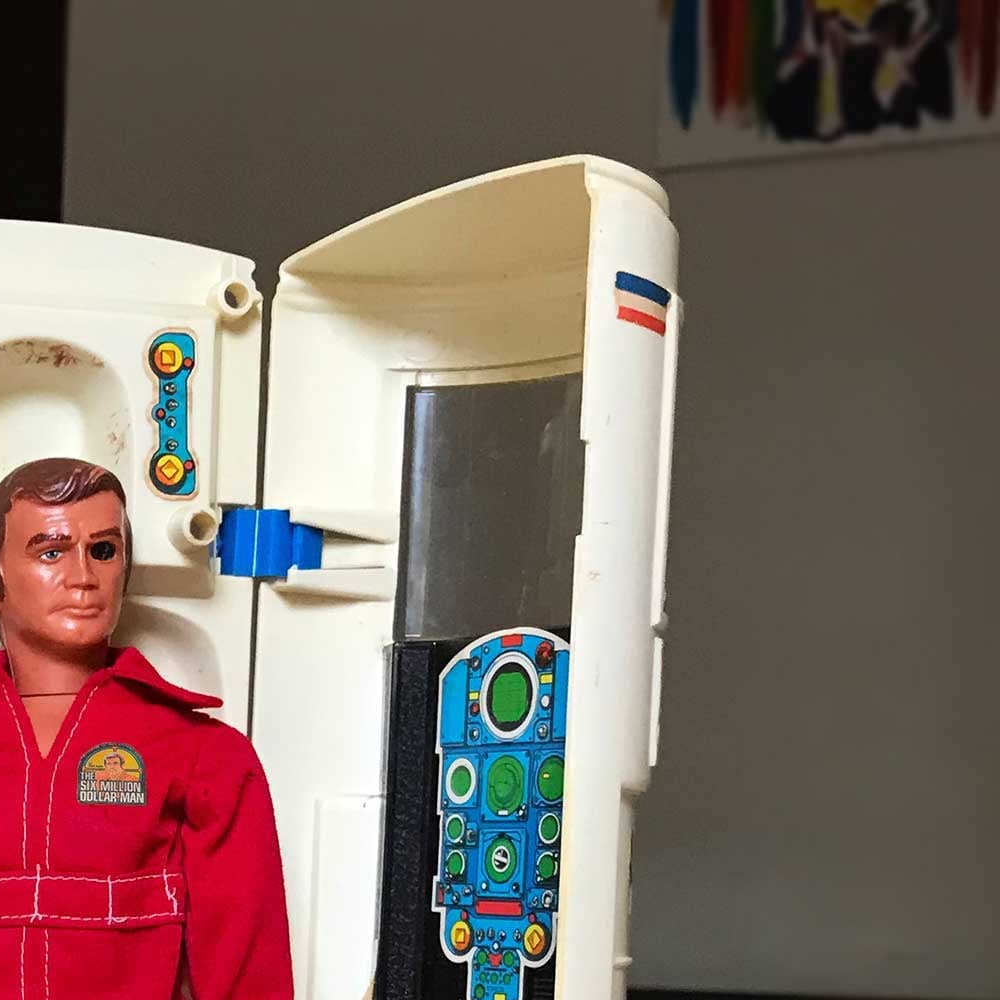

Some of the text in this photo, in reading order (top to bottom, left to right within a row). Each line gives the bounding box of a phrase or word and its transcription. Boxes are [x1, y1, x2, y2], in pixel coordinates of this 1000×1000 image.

[80, 771, 95, 780] THE
[80, 780, 141, 792] SIX MILLION
[80, 790, 145, 804] DOLLAR MAN
